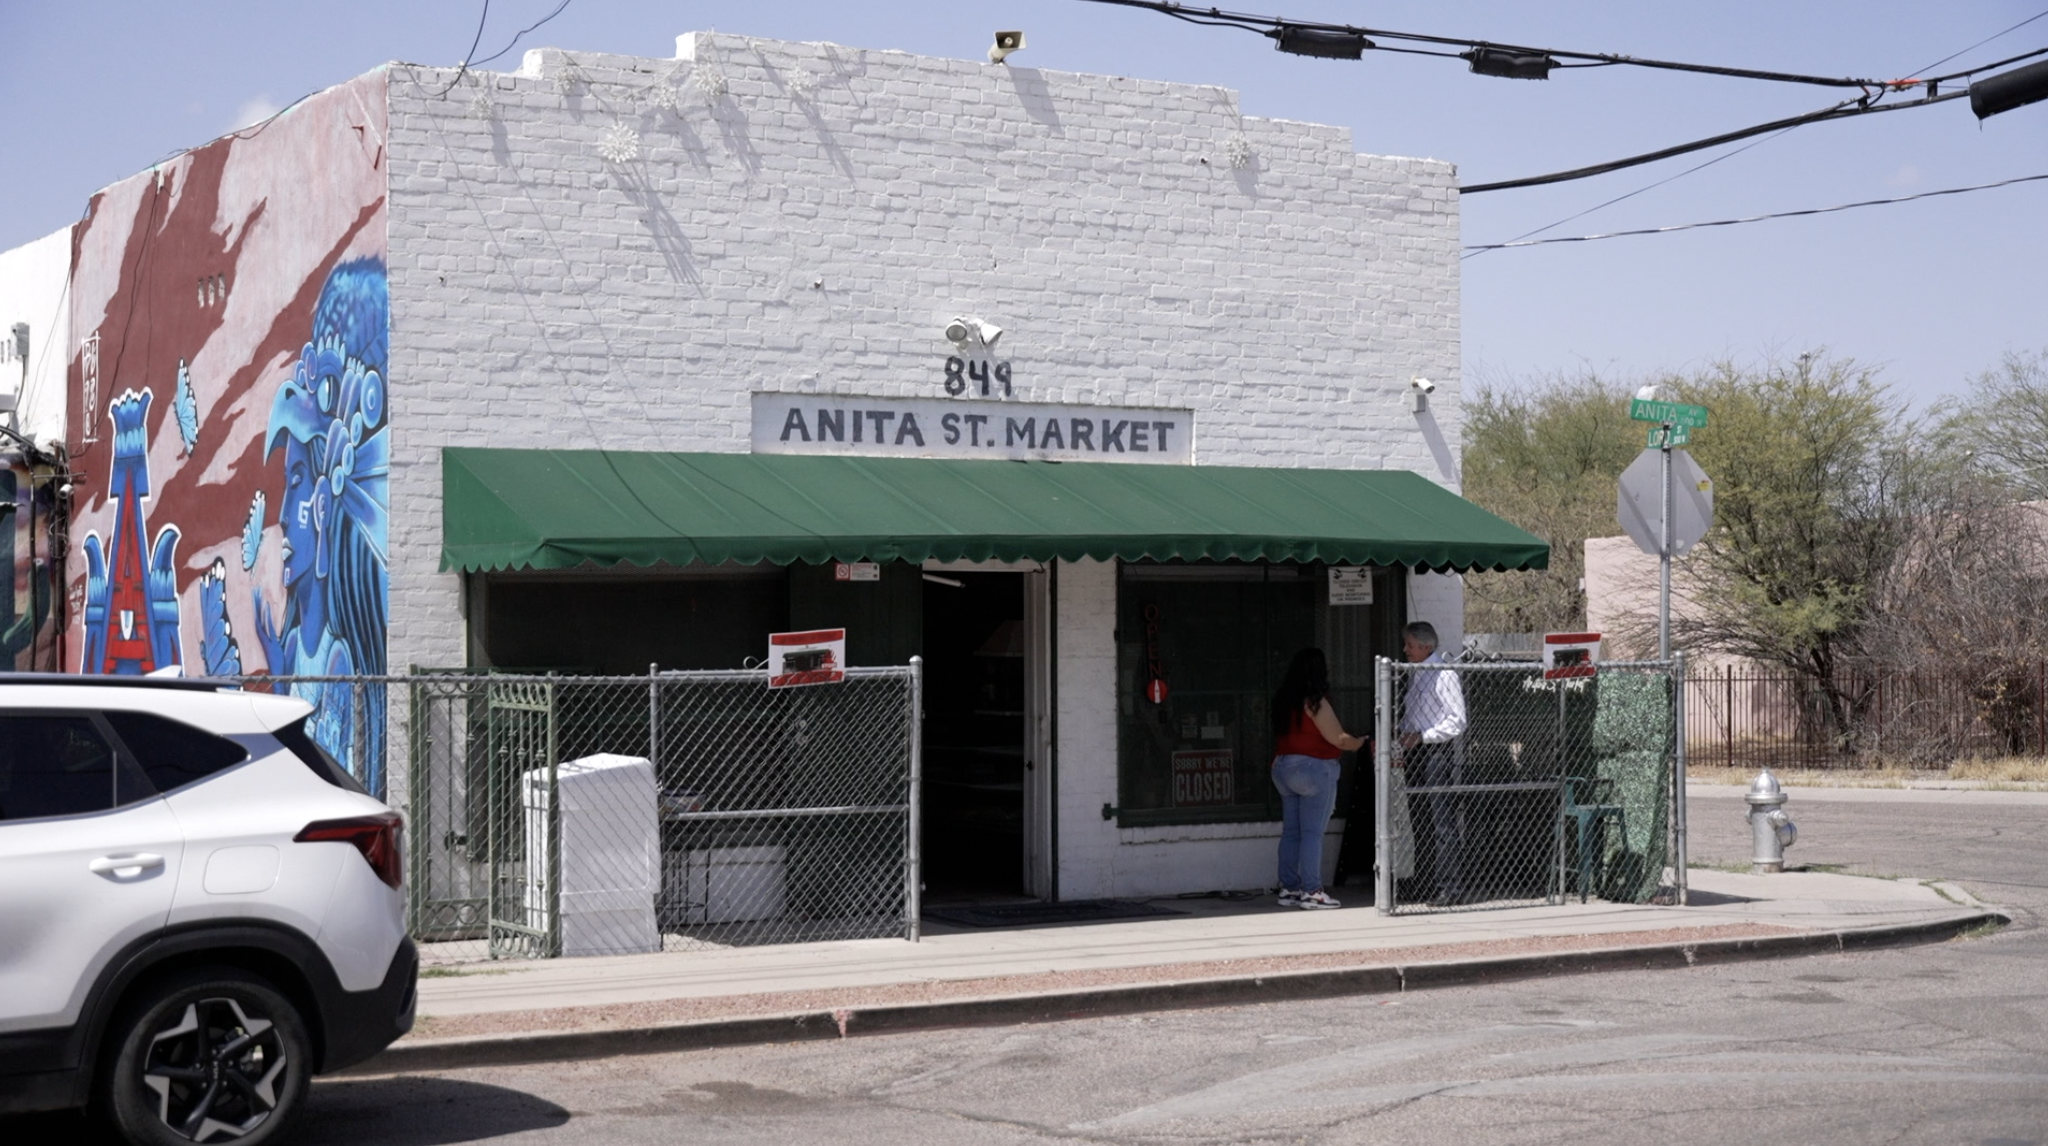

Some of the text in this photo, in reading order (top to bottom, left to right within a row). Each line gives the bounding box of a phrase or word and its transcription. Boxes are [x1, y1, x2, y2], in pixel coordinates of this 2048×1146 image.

[944, 356, 1012, 397] 849
[1635, 402, 1678, 423] ANITA
[780, 408, 1175, 452] ANITA ST. MARKET
[1648, 430, 1671, 447] LORD
[1144, 603, 1162, 679] OPEN
[1175, 758, 1202, 771] SORRY
[1175, 771, 1231, 802] CLOSED
